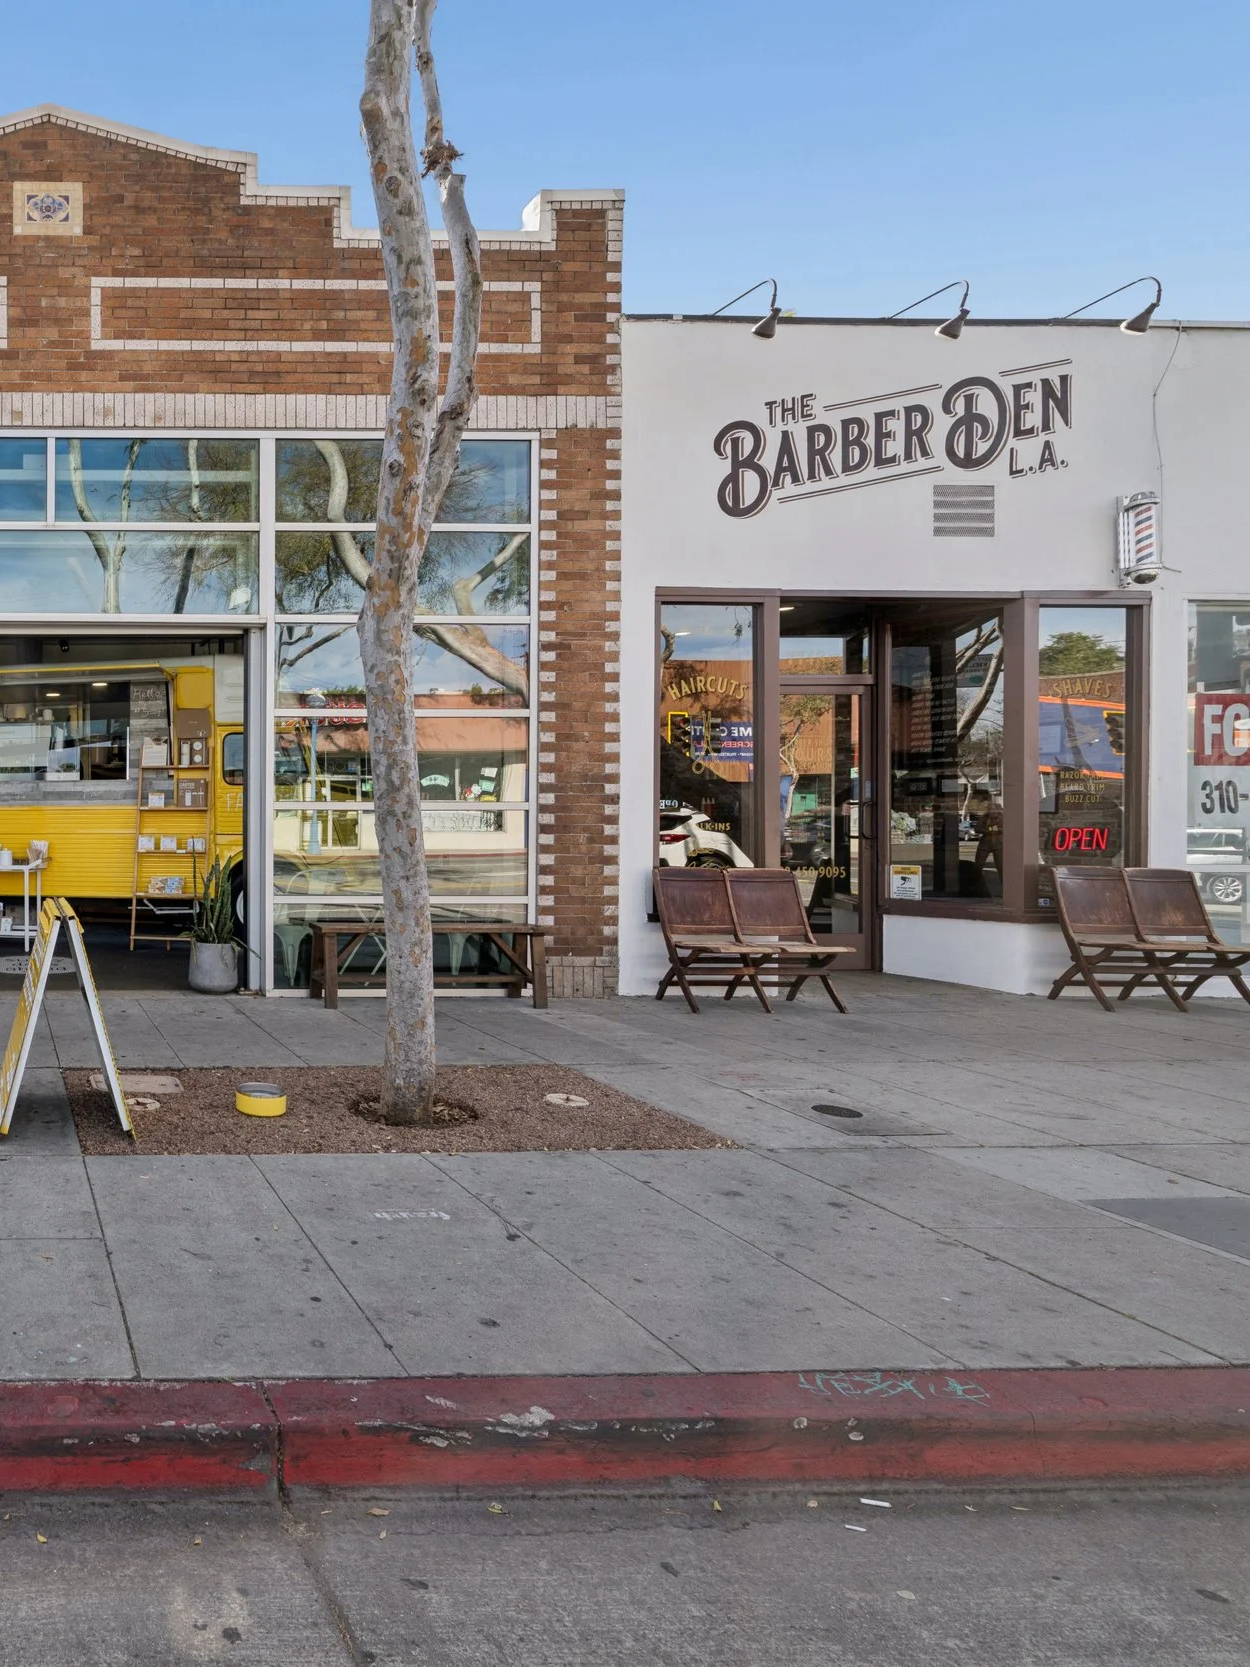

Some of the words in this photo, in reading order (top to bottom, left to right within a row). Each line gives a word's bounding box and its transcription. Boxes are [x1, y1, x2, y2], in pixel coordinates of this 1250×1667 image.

[764, 393, 817, 426] THE
[713, 401, 936, 520] BARBER
[941, 373, 1074, 471] DEN
[1008, 440, 1069, 478] L.A.
[667, 676, 749, 700] HAIRCUTS
[1052, 677, 1113, 699] SHAVES
[1060, 771, 1084, 779] RAZOR
[1060, 783, 1084, 791] BEARD
[1087, 783, 1105, 791] TRIM
[1065, 794, 1084, 803] BUZZ
[1086, 794, 1101, 803] CUT
[1054, 827, 1108, 851] OPEN
